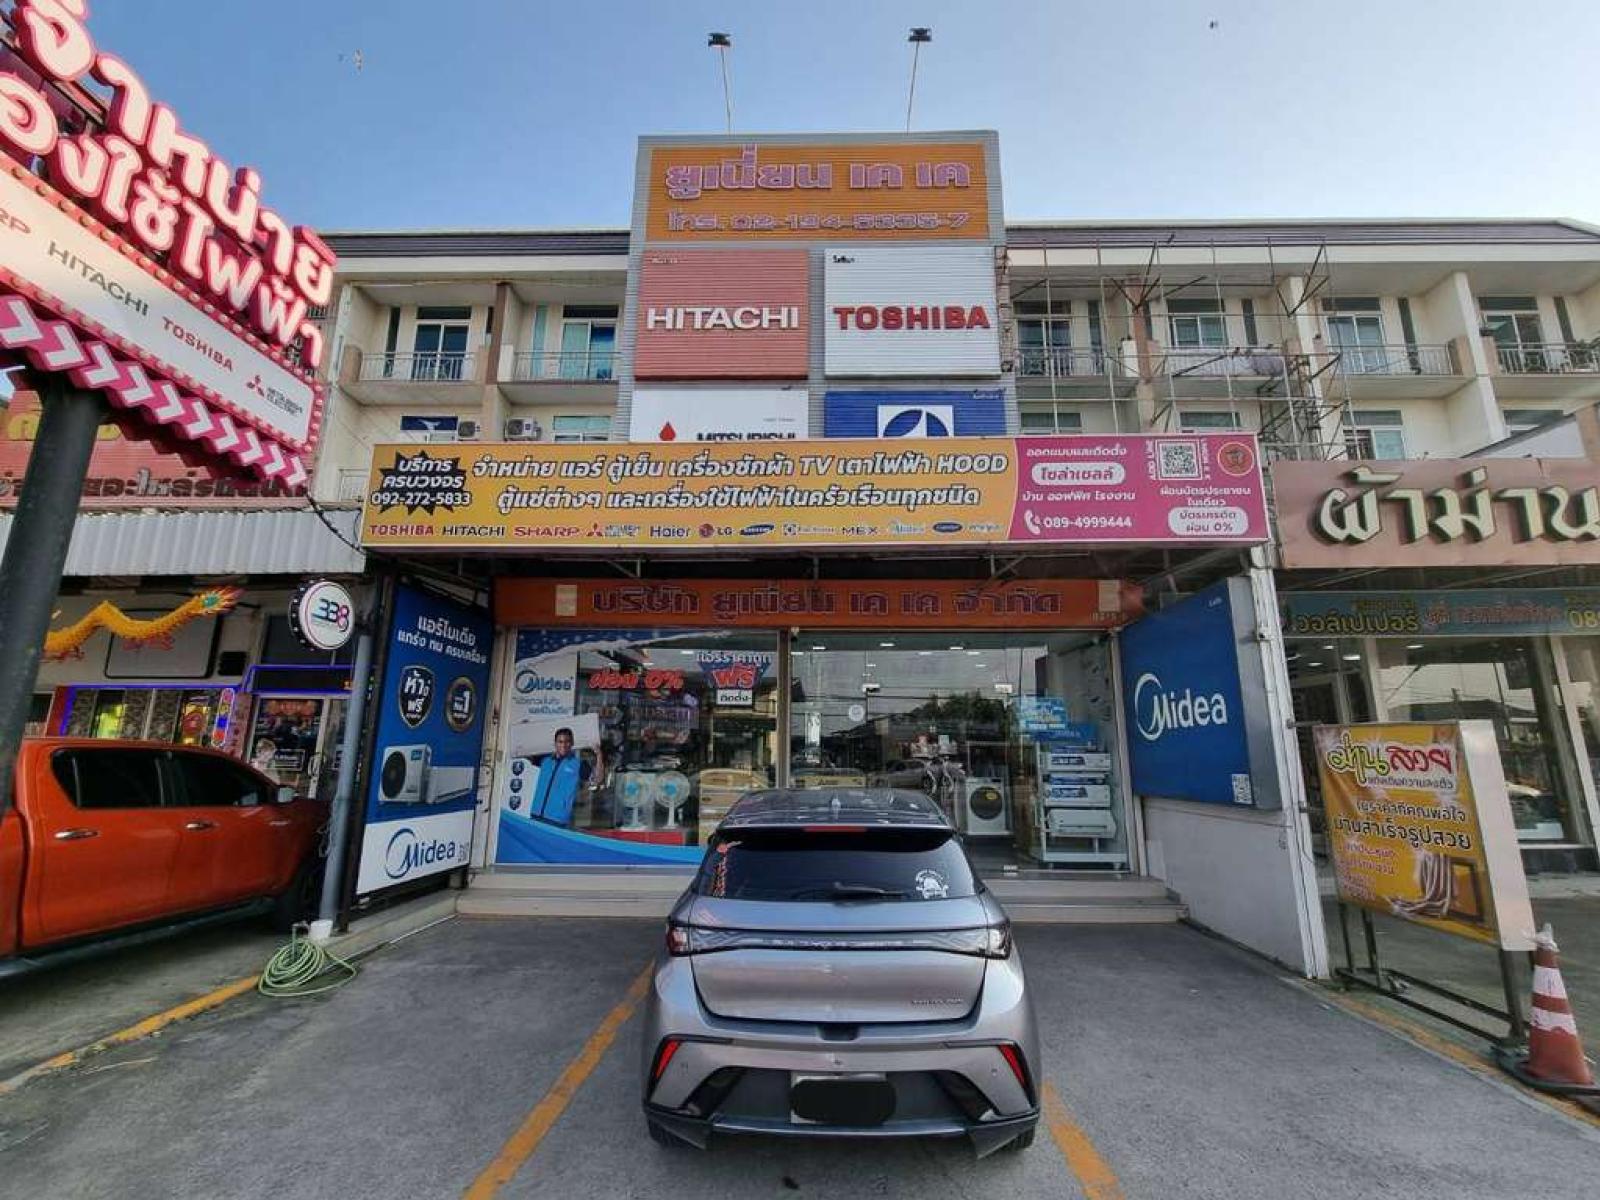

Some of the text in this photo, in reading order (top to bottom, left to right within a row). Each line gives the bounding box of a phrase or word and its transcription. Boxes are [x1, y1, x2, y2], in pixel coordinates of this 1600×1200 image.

[665, 143, 971, 199] ยูเนี่ยน เค เค
[46, 240, 149, 317] HITACHI
[646, 307, 799, 331] HITACHI
[833, 305, 991, 331] TOSHIBA
[161, 315, 234, 373] TOSHIBA
[399, 456, 453, 472] บริการ
[473, 449, 1009, 483] จำหน่าย แอร์ ตู้เย็น เครื่องซักผ้า TV เตาไฟฟ้า HOOD
[383, 476, 465, 488] ครบวงจร
[371, 492, 471, 505] 092-272-5833
[1318, 464, 1600, 544] ผ้าม่าน
[369, 525, 434, 536] TOSHIBA
[442, 526, 506, 536] HITACHI
[513, 526, 580, 537] SHARP
[650, 525, 691, 537] Haier
[717, 526, 733, 536] LG
[842, 526, 878, 535] MEX
[1214, 522, 1233, 532] 0%
[1135, 673, 1228, 741] Midea
[386, 828, 456, 879] Midea
